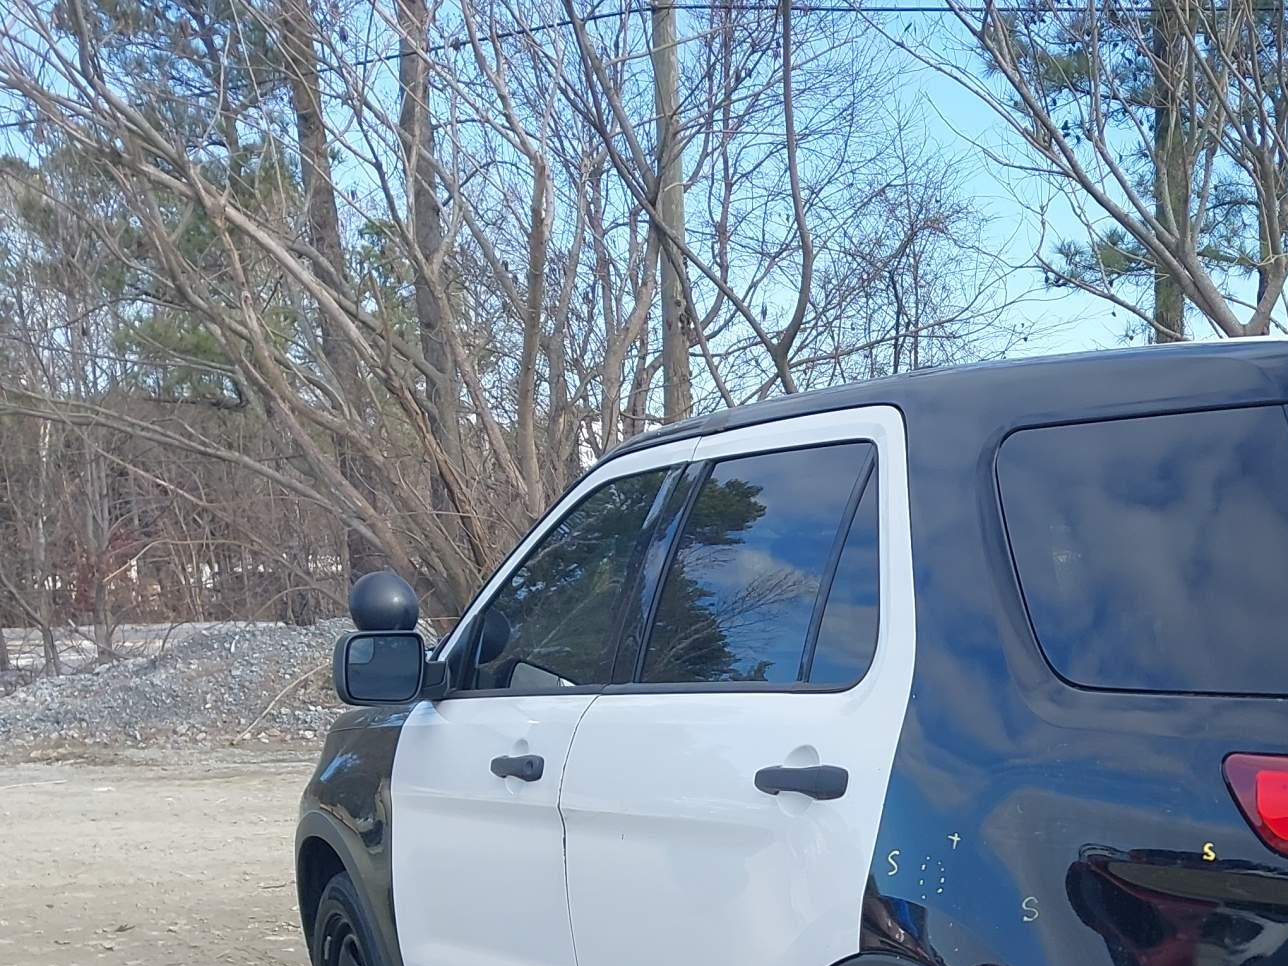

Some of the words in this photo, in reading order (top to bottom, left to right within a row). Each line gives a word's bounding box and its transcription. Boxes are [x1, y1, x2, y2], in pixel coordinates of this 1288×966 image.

[887, 850, 900, 876] S
[1202, 842, 1216, 861] S
[1022, 896, 1039, 921] S
